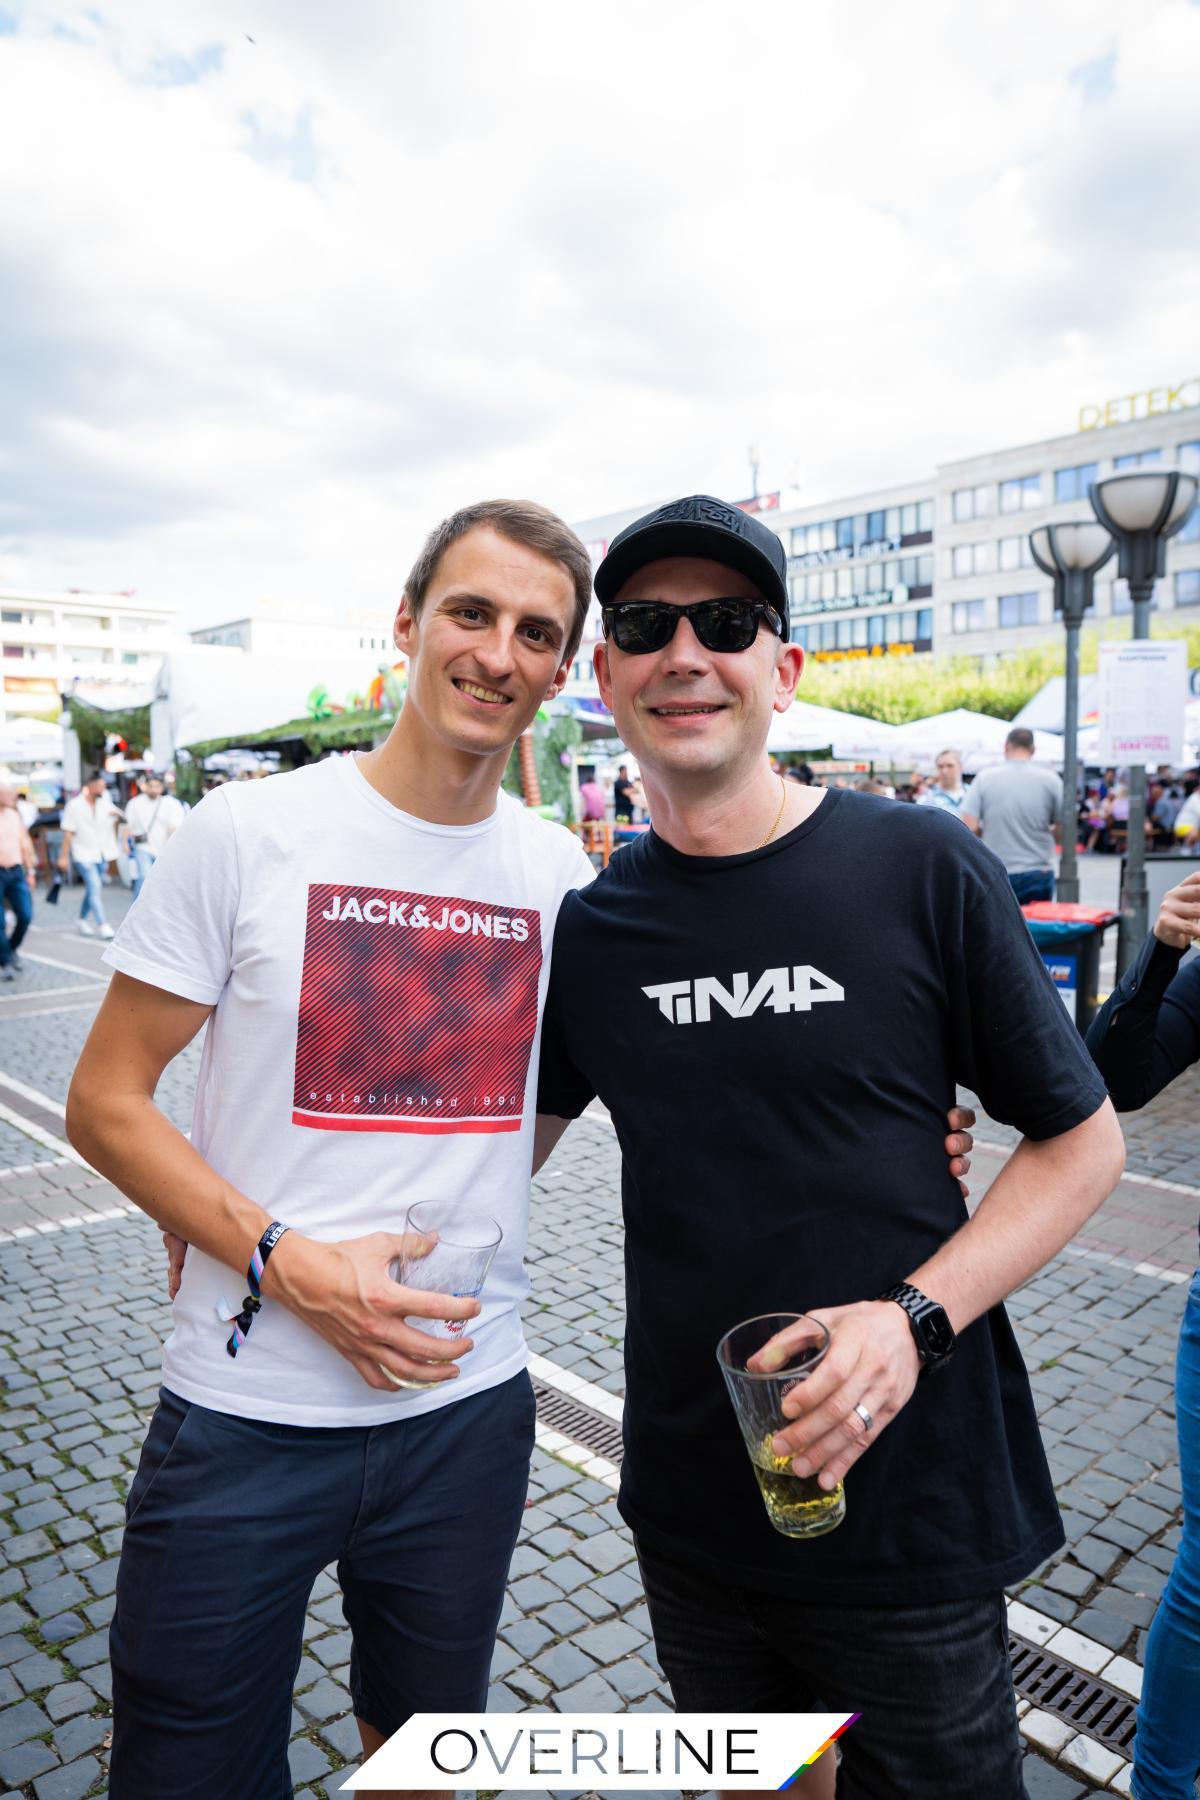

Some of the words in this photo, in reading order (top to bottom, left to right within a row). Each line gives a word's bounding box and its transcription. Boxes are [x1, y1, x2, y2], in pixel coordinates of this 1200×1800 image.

[322, 896, 529, 942] JACK&JONES
[310, 1092, 458, 1107] established
[473, 1092, 516, 1106] 1990
